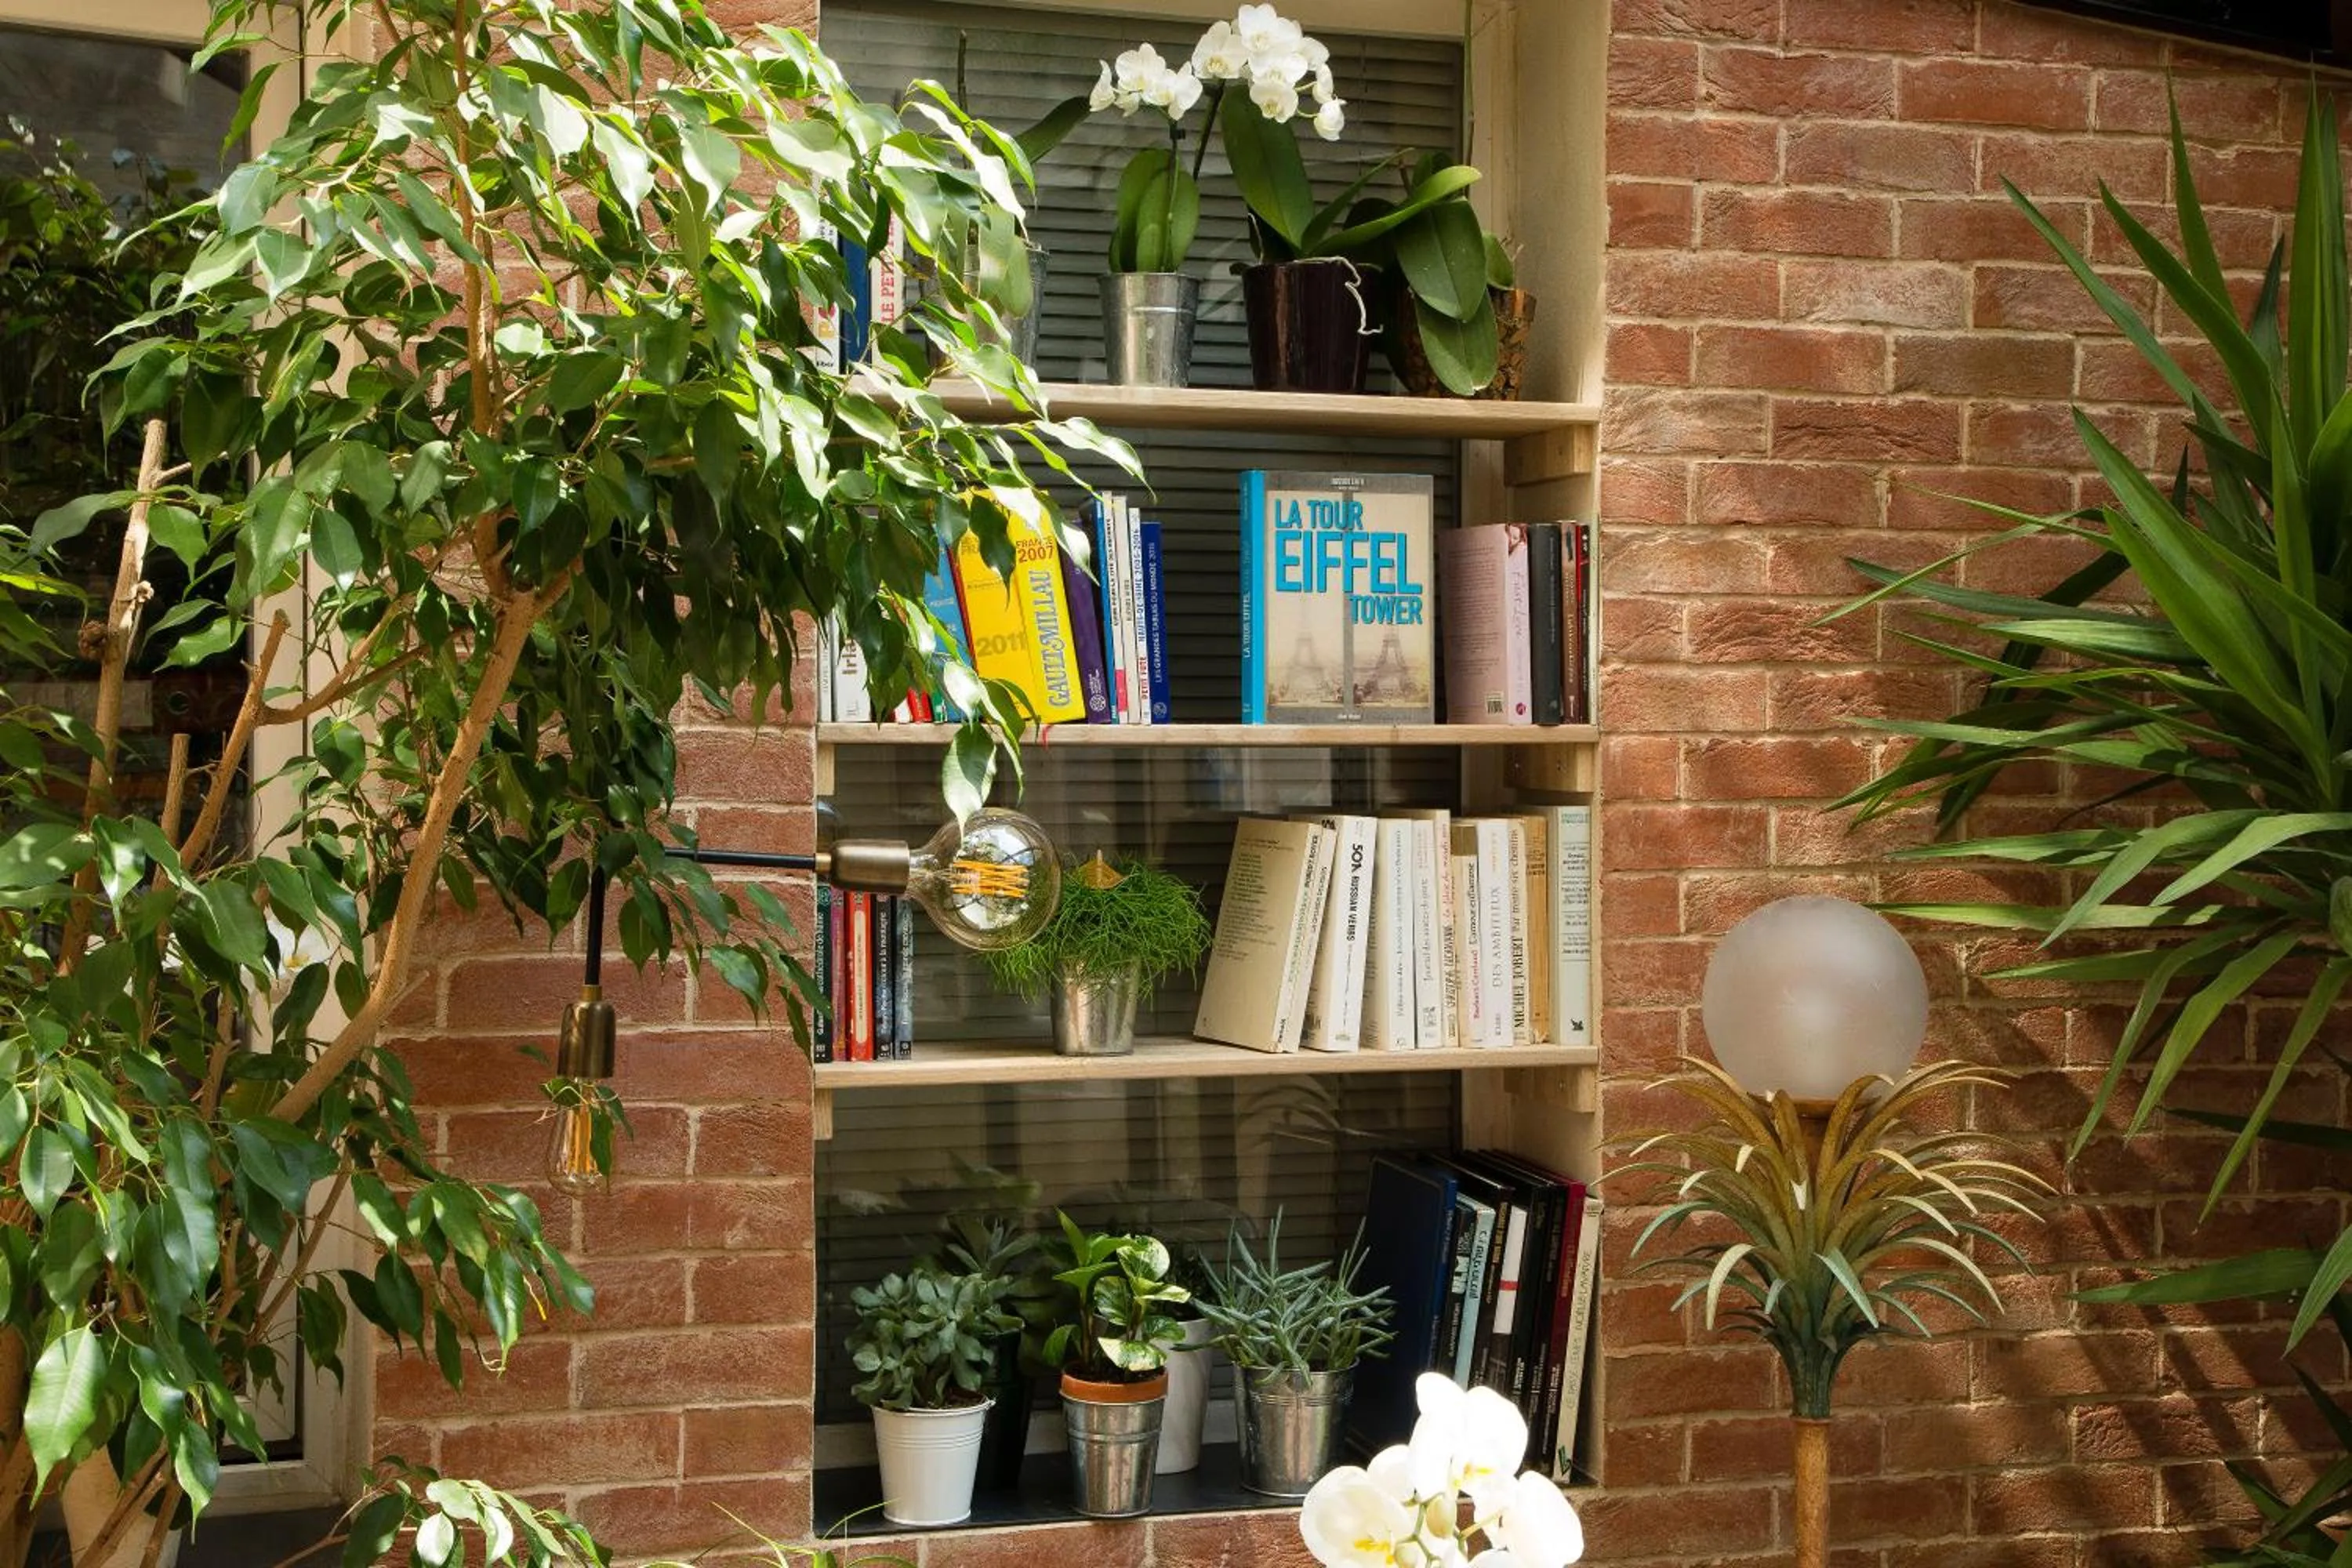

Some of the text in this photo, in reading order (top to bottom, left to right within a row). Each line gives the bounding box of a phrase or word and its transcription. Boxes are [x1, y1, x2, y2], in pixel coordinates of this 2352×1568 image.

[880, 303, 895, 324] LE
[1274, 499, 1301, 528] LA
[1308, 499, 1363, 530] TOUR
[1018, 546, 1054, 564] 2007
[1275, 531, 1423, 594] EIFFEL
[1348, 595, 1423, 625] TOWER
[841, 643, 858, 675] Irla
[1348, 876, 1360, 912] RUSSIAN
[1346, 914, 1358, 942] VERBS
[1512, 935, 1526, 1029] MICHEL JOBERT
